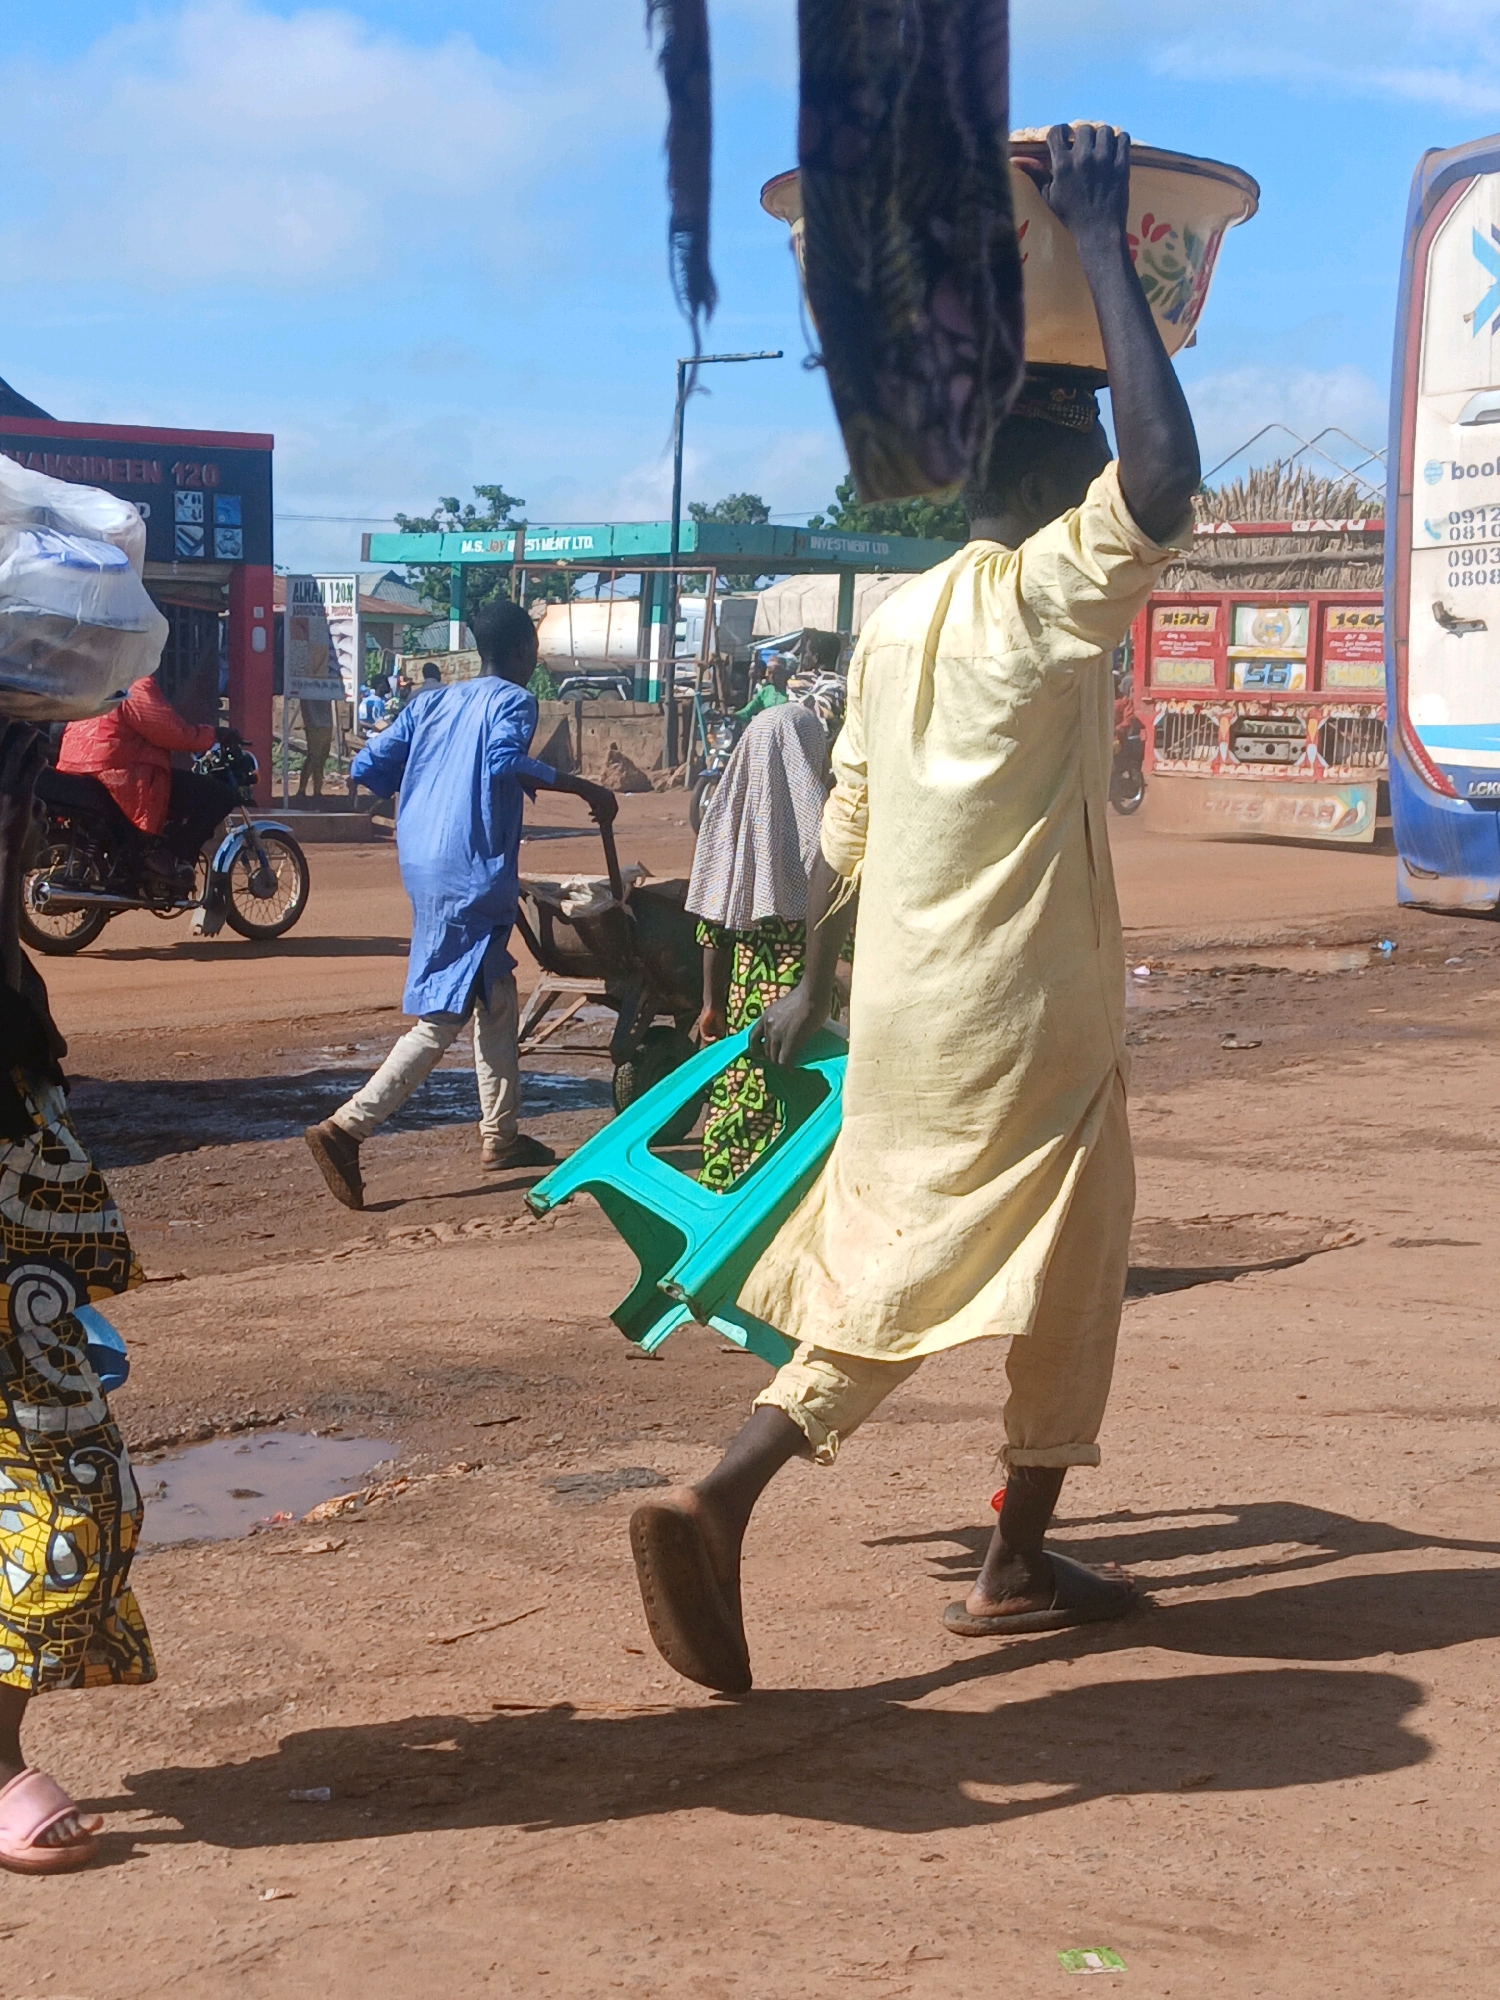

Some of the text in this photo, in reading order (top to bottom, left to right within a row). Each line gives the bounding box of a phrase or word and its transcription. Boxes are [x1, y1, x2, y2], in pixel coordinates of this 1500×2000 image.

[172, 460, 221, 487] 120
[1448, 507, 1500, 525] 0912
[1449, 524, 1500, 541] 0810
[810, 536, 871, 553] INVESTMENT
[1448, 547, 1500, 568] 0903
[1448, 569, 1500, 588] 0808
